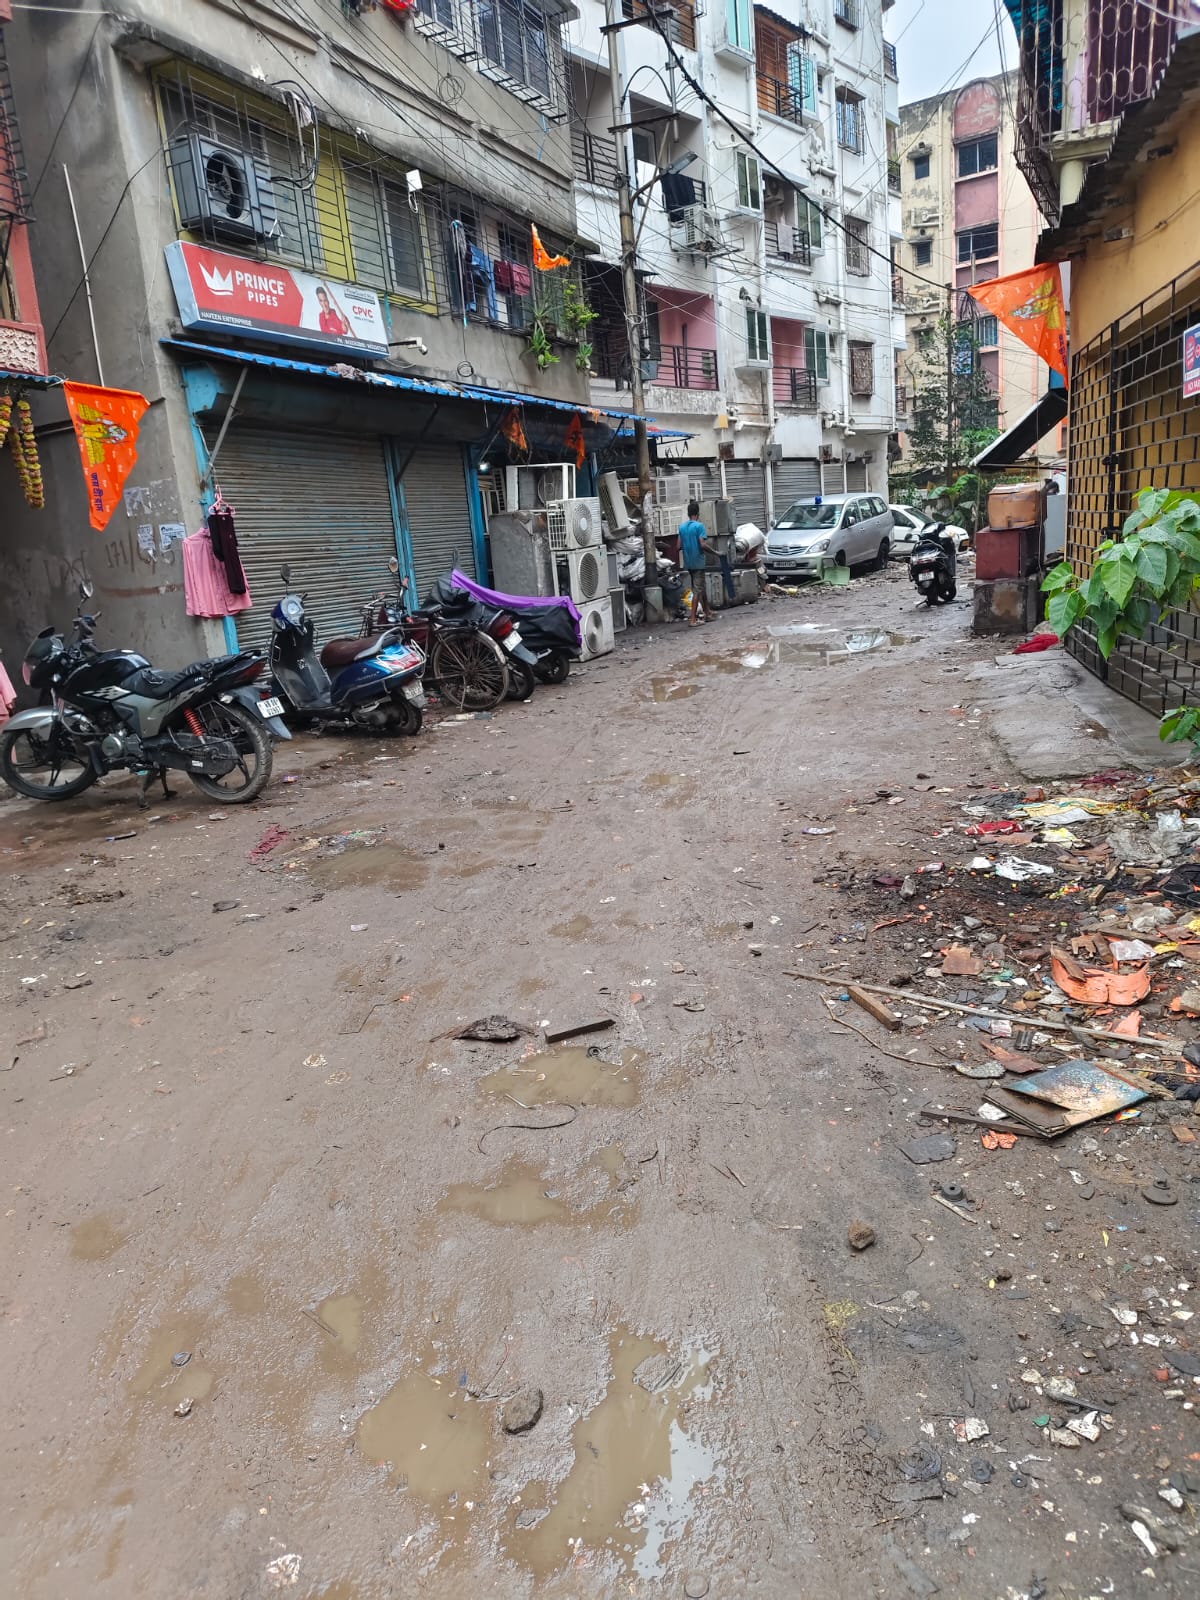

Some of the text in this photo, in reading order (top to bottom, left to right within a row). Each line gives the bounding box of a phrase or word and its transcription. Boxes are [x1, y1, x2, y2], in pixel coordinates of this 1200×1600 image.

[235, 270, 285, 296] PRINCE
[247, 290, 279, 307] PIPES
[352, 305, 374, 319] CPVC
